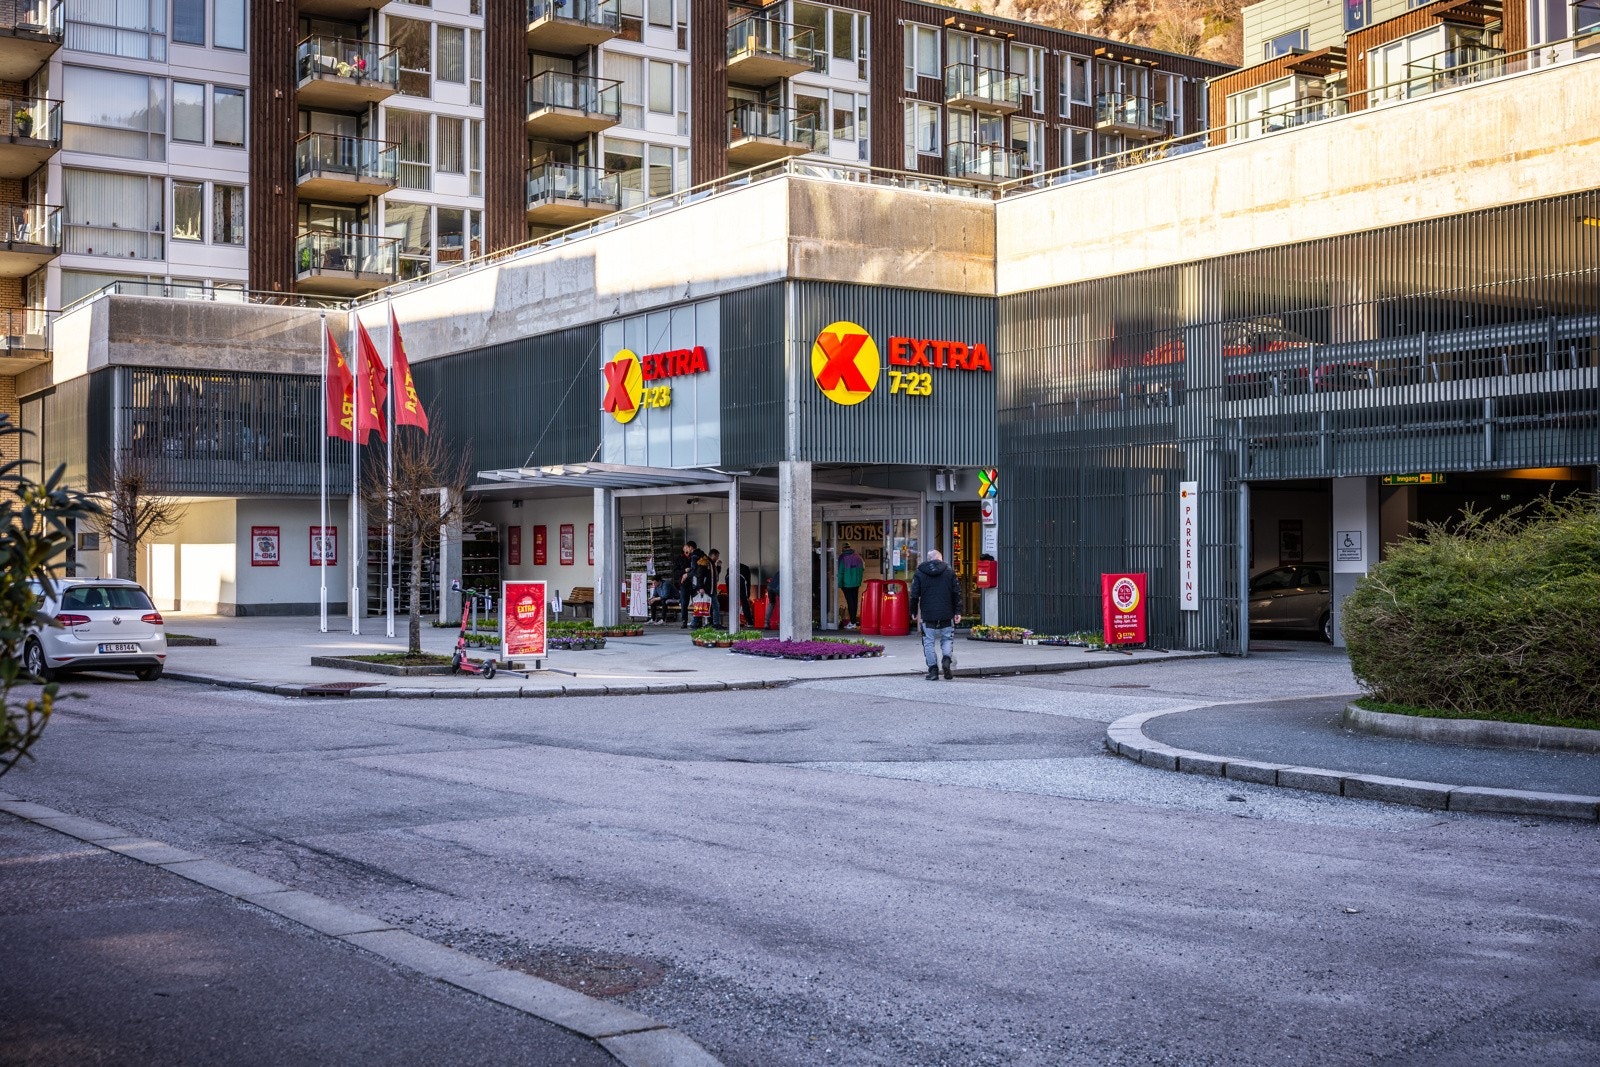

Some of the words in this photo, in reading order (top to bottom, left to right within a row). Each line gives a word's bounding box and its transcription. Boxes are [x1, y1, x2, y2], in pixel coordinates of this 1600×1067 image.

[642, 346, 709, 381] EXTRA
[889, 335, 992, 372] EXTRA
[641, 385, 671, 409] 7-23
[888, 370, 933, 396] 7-23
